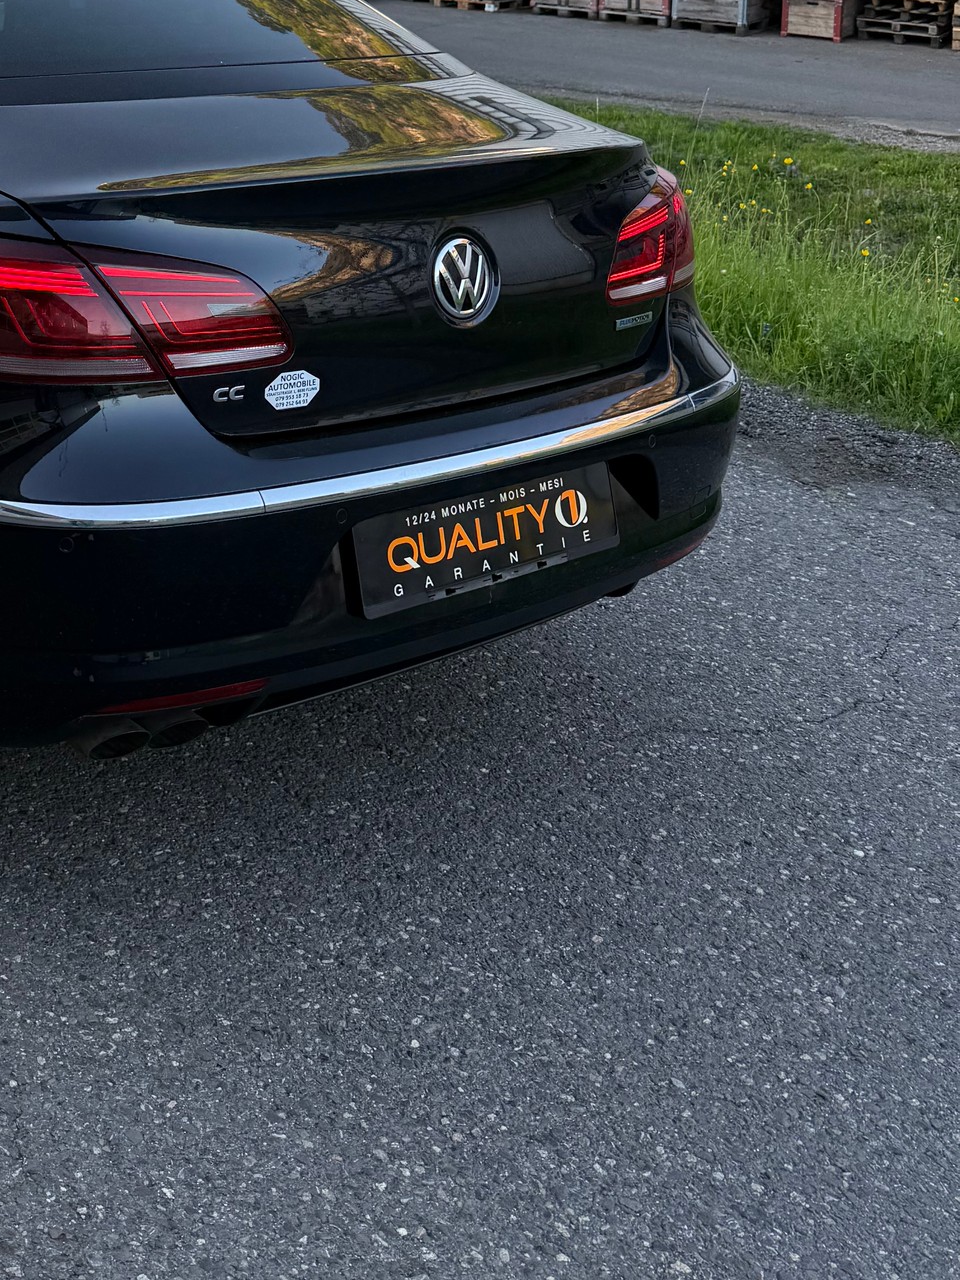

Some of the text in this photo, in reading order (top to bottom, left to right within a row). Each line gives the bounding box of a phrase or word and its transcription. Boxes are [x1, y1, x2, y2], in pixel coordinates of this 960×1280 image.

[435, 238, 489, 316] VW
[212, 385, 245, 402] CC
[268, 378, 316, 391] AUTOMOBILE
[280, 372, 305, 383] NOGIC
[405, 510, 437, 527] 12/24
[441, 498, 485, 517] MONATE
[500, 488, 526, 502] MOIS
[540, 477, 564, 492] MESI
[387, 498, 550, 573] QUALITY
[394, 530, 590, 597] GARANTIE
